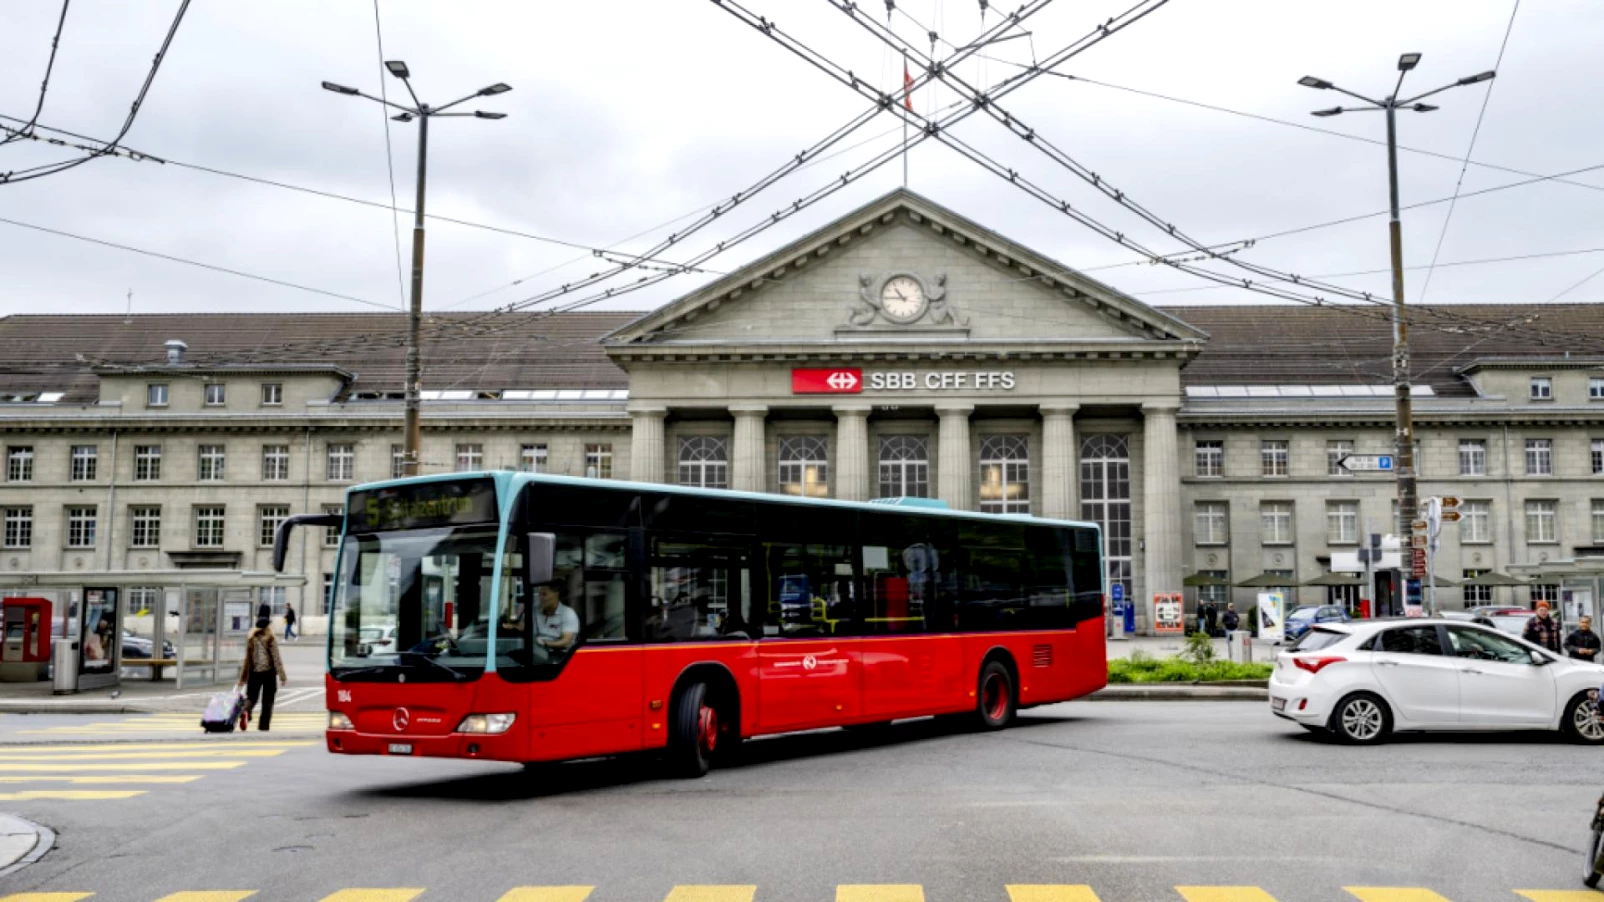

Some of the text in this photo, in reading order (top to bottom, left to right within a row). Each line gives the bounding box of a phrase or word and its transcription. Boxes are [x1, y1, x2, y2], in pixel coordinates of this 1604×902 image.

[871, 372, 1015, 389] SBB CFF FFS
[365, 496, 380, 526] 5
